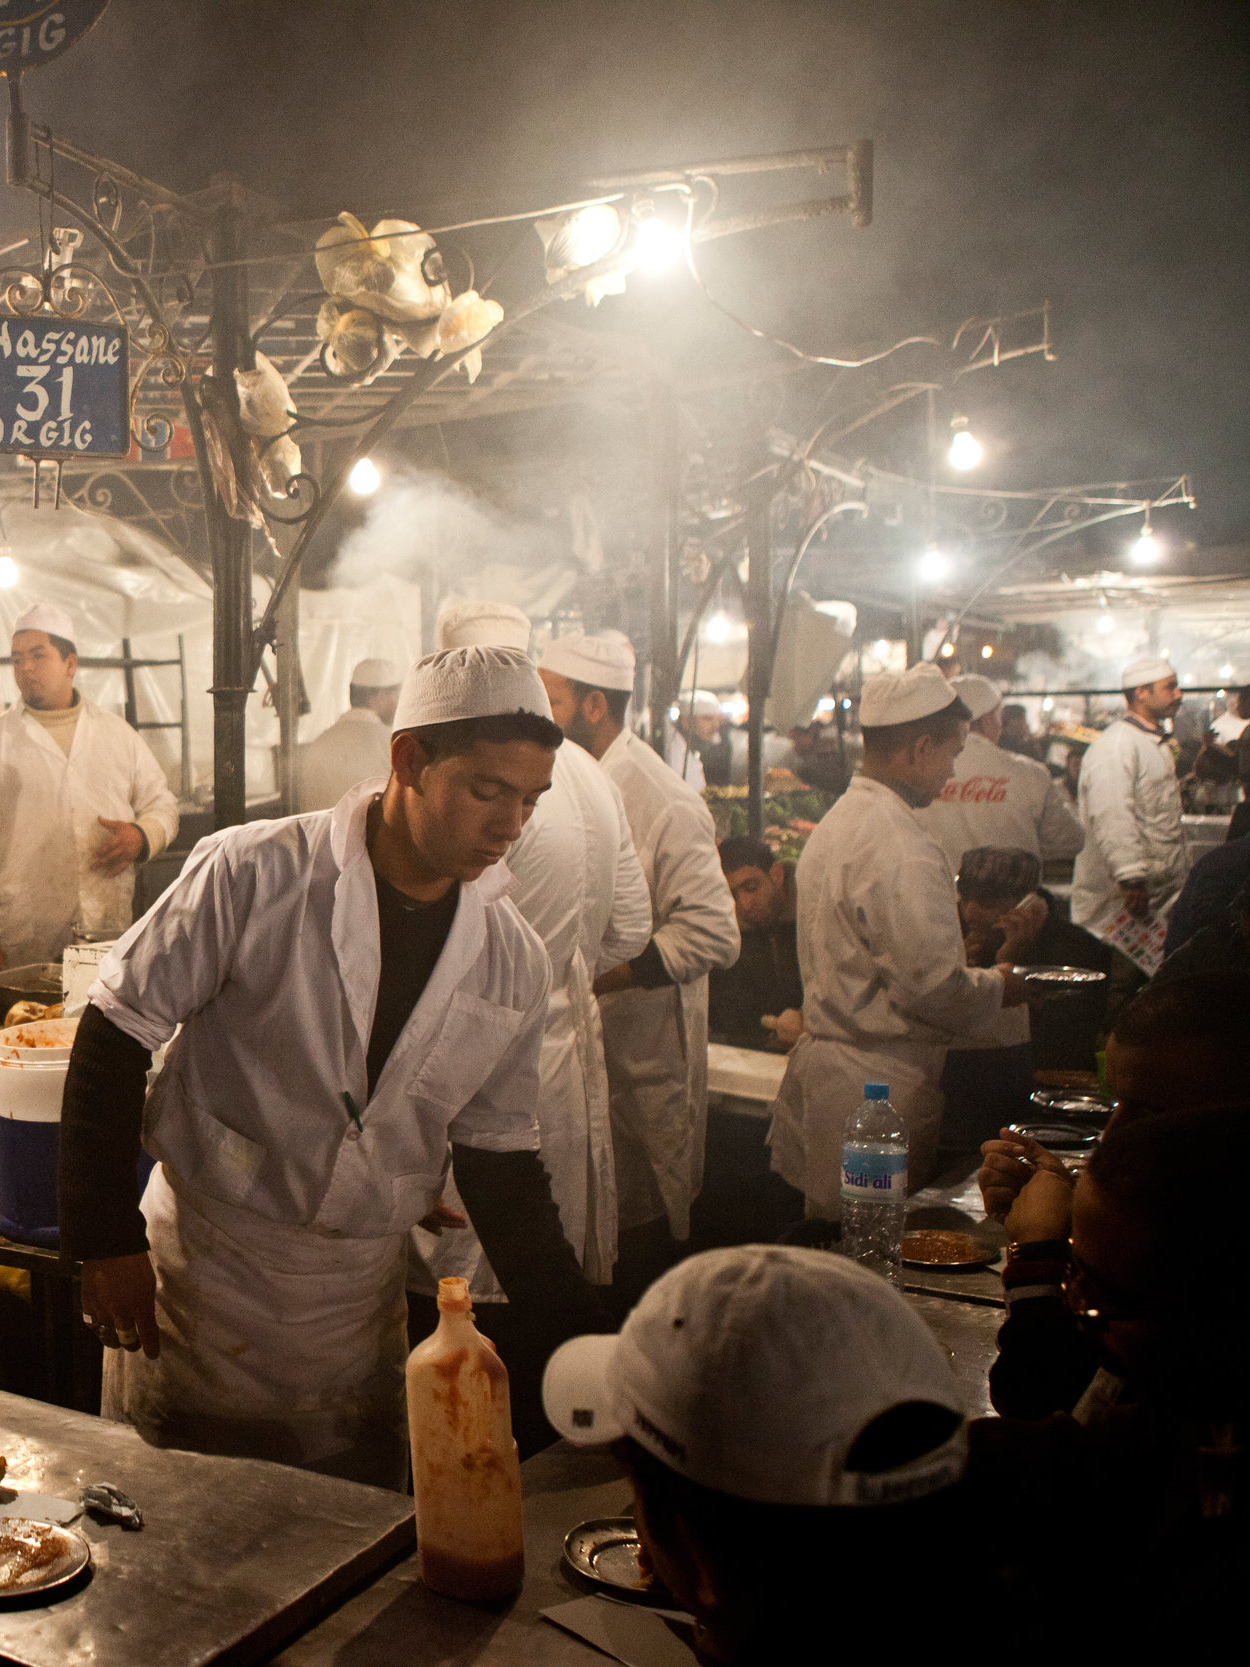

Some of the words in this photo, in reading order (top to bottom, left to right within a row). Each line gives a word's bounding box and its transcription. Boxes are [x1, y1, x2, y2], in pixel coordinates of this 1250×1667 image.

[15, 364, 74, 422] 31
[845, 1169, 868, 1188] Sidi
[873, 1174, 892, 1189] ali
